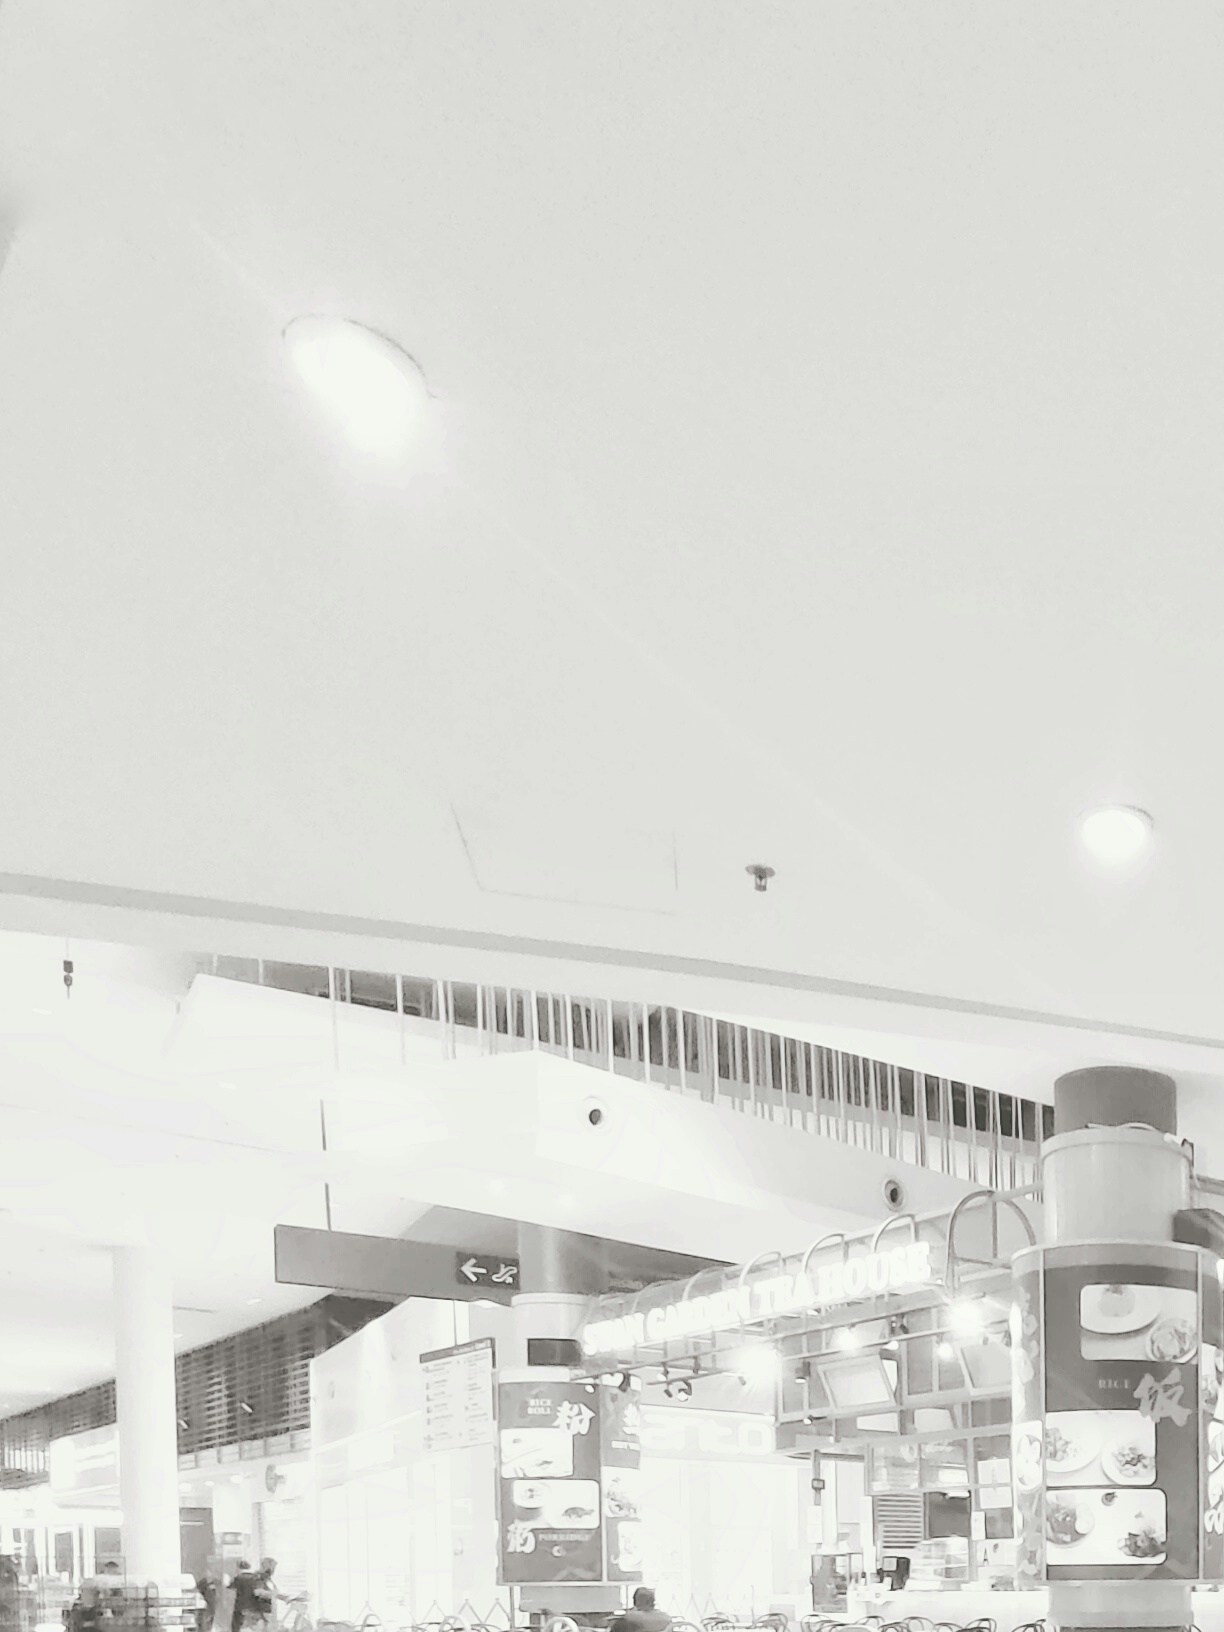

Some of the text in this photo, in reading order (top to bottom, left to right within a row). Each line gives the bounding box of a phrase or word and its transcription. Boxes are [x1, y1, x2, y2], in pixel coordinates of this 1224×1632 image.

[752, 1271, 814, 1318] TEA
[817, 1241, 932, 1303] HOUSE
[1098, 1379, 1130, 1389] RICE
